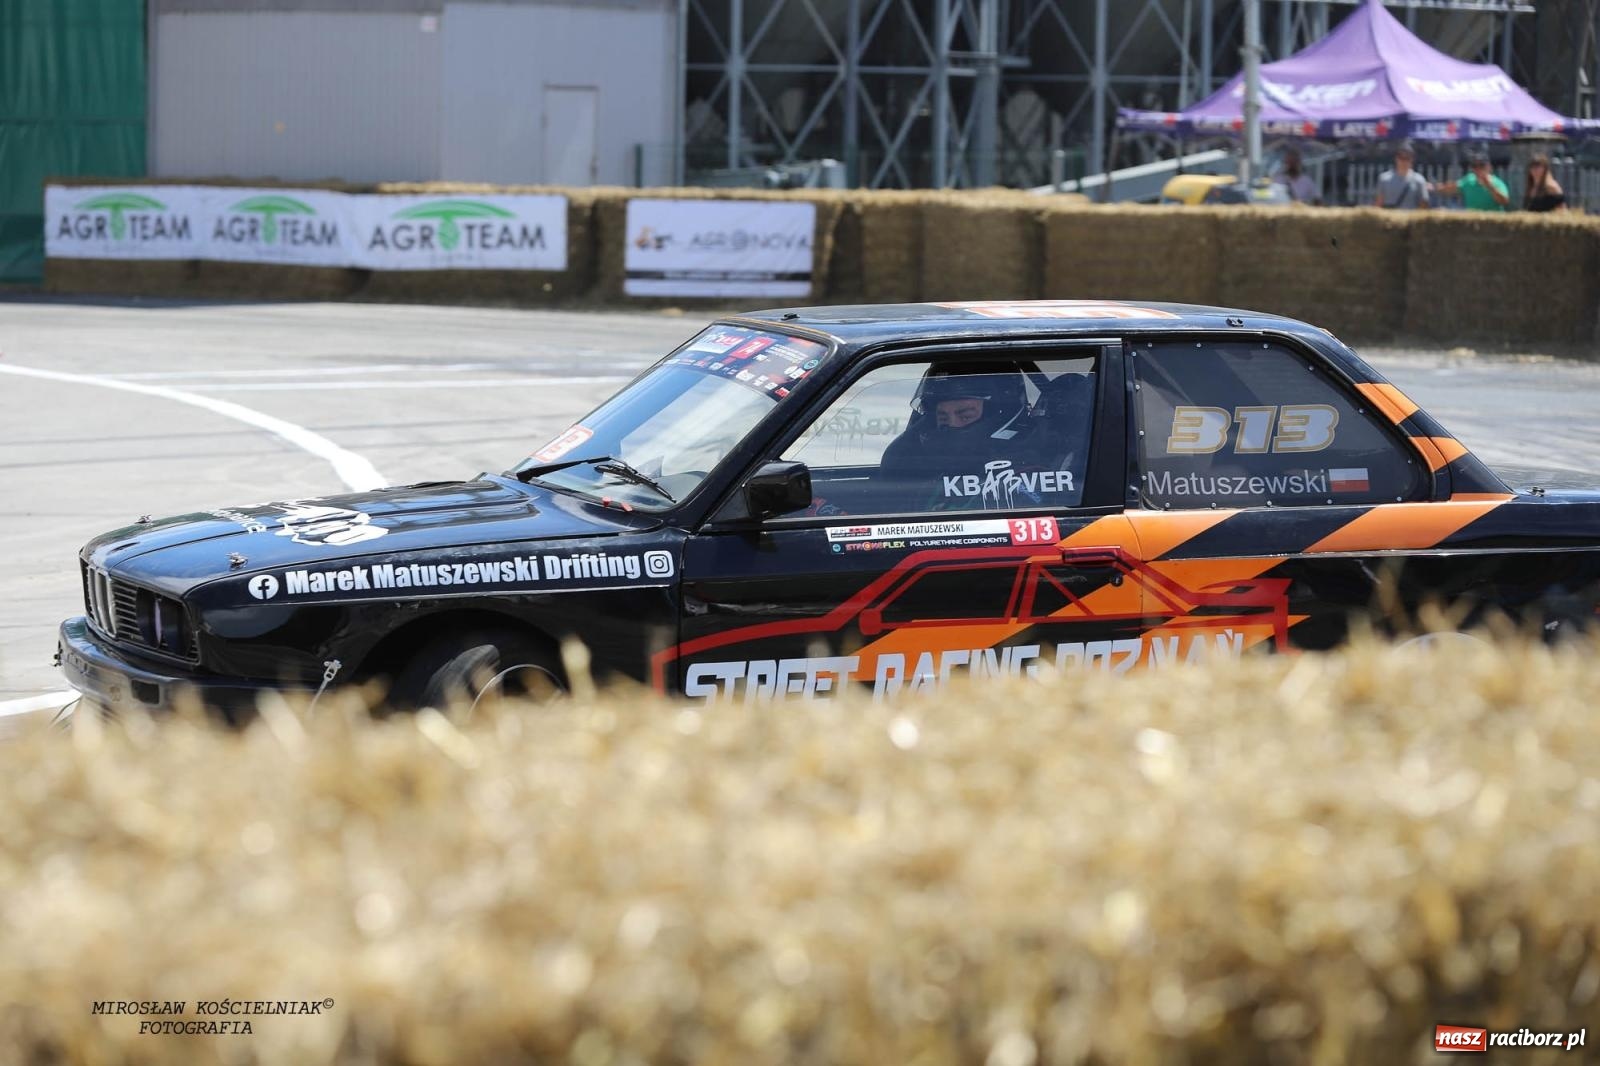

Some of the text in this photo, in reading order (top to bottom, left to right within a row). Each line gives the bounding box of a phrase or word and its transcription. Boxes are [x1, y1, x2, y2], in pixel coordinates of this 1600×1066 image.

[1167, 404, 1340, 454] 313
[1147, 468, 1328, 496] Matuszewski
[877, 526, 906, 536] MAREK
[907, 524, 964, 534] MATUSZEWSKI
[1014, 519, 1054, 543] 313
[285, 552, 641, 595] Marek Matuszewski Drifting
